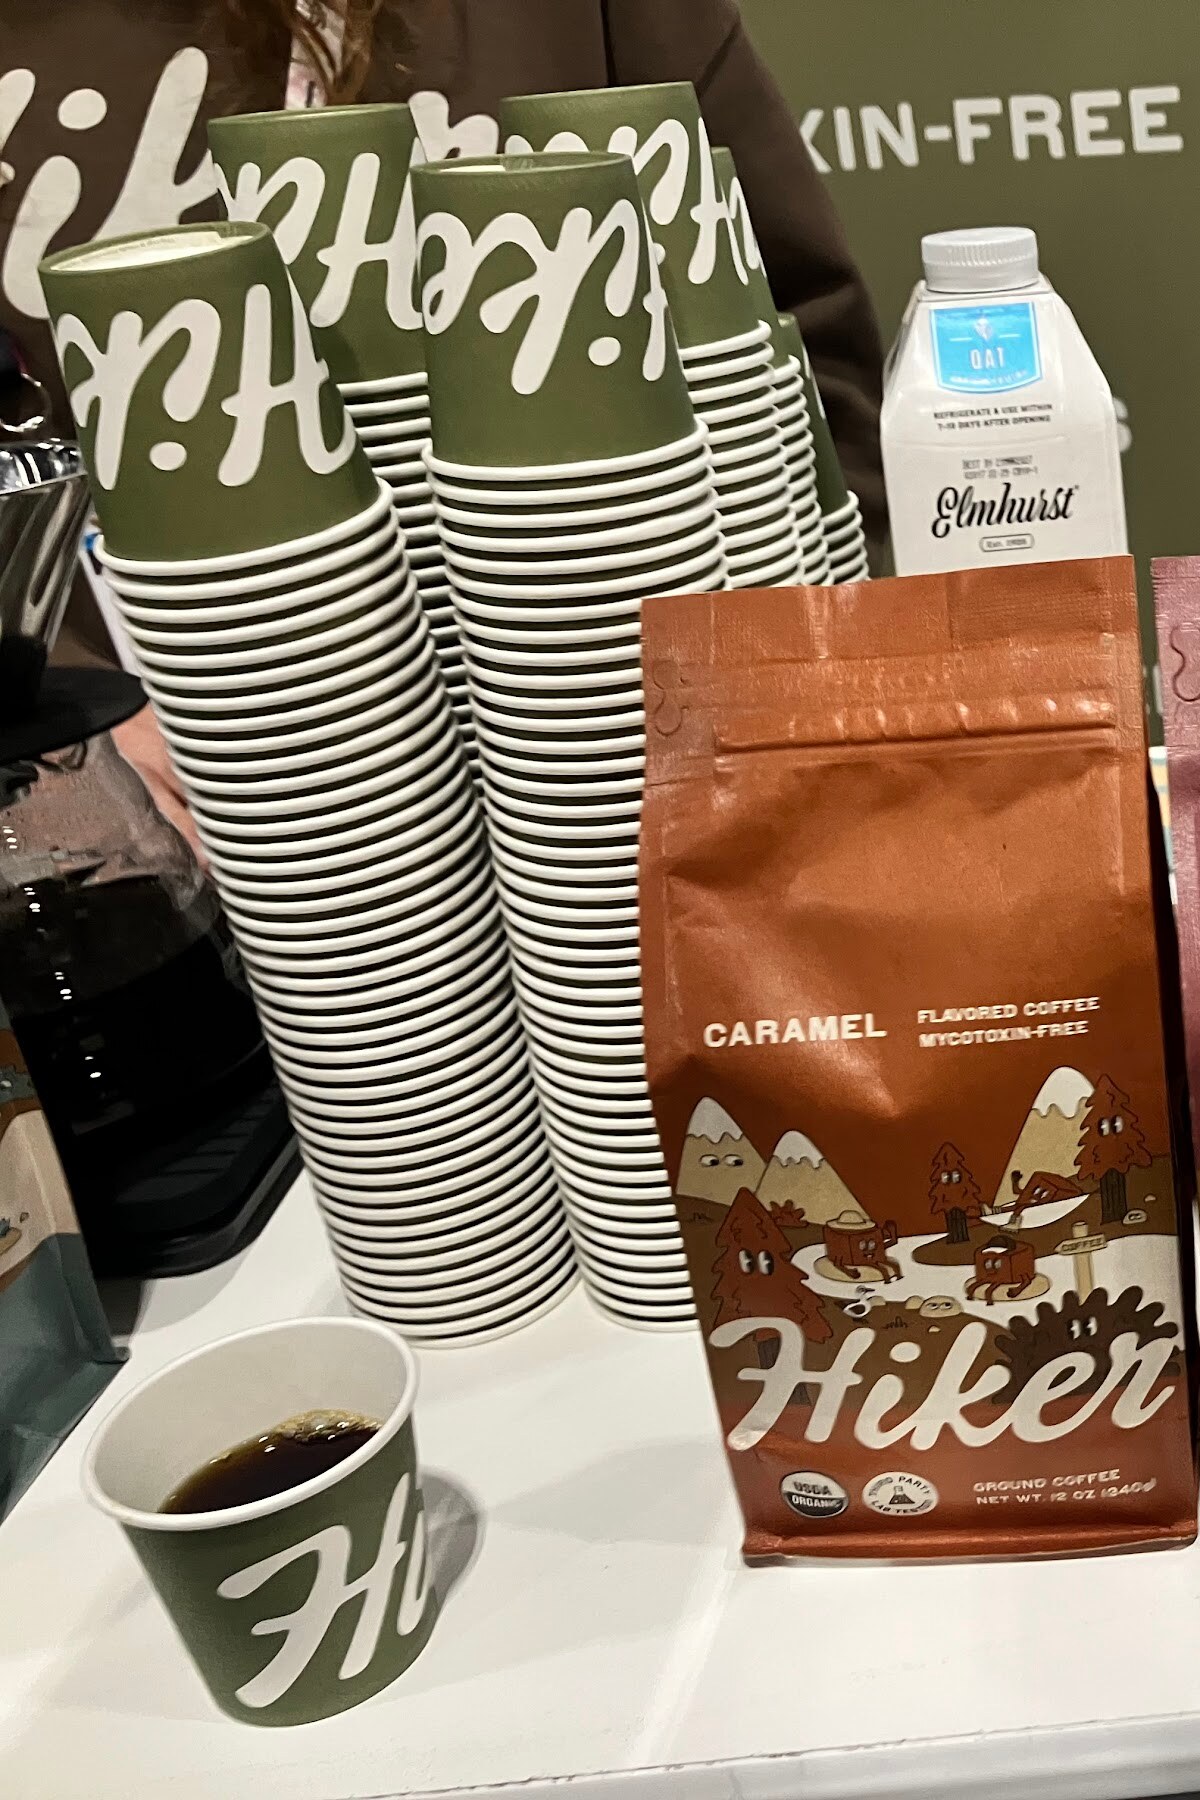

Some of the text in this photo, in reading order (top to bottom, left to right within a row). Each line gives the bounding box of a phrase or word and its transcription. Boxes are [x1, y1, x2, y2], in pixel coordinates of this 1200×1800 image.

[931, 482, 1074, 538] Elmhurst
[918, 996, 1100, 1024] FLAVORED COFFEE
[703, 1013, 887, 1048] CARAMEL
[919, 1020, 1089, 1048] MYCOTOXIN-FREE
[709, 1316, 1182, 1451] Hiker
[793, 1481, 832, 1495] USDA
[973, 1468, 1120, 1492] GROUND COFFEE
[976, 1495, 1010, 1504] NET
[1050, 1491, 1067, 1502] 12
[1072, 1489, 1096, 1500] OZ
